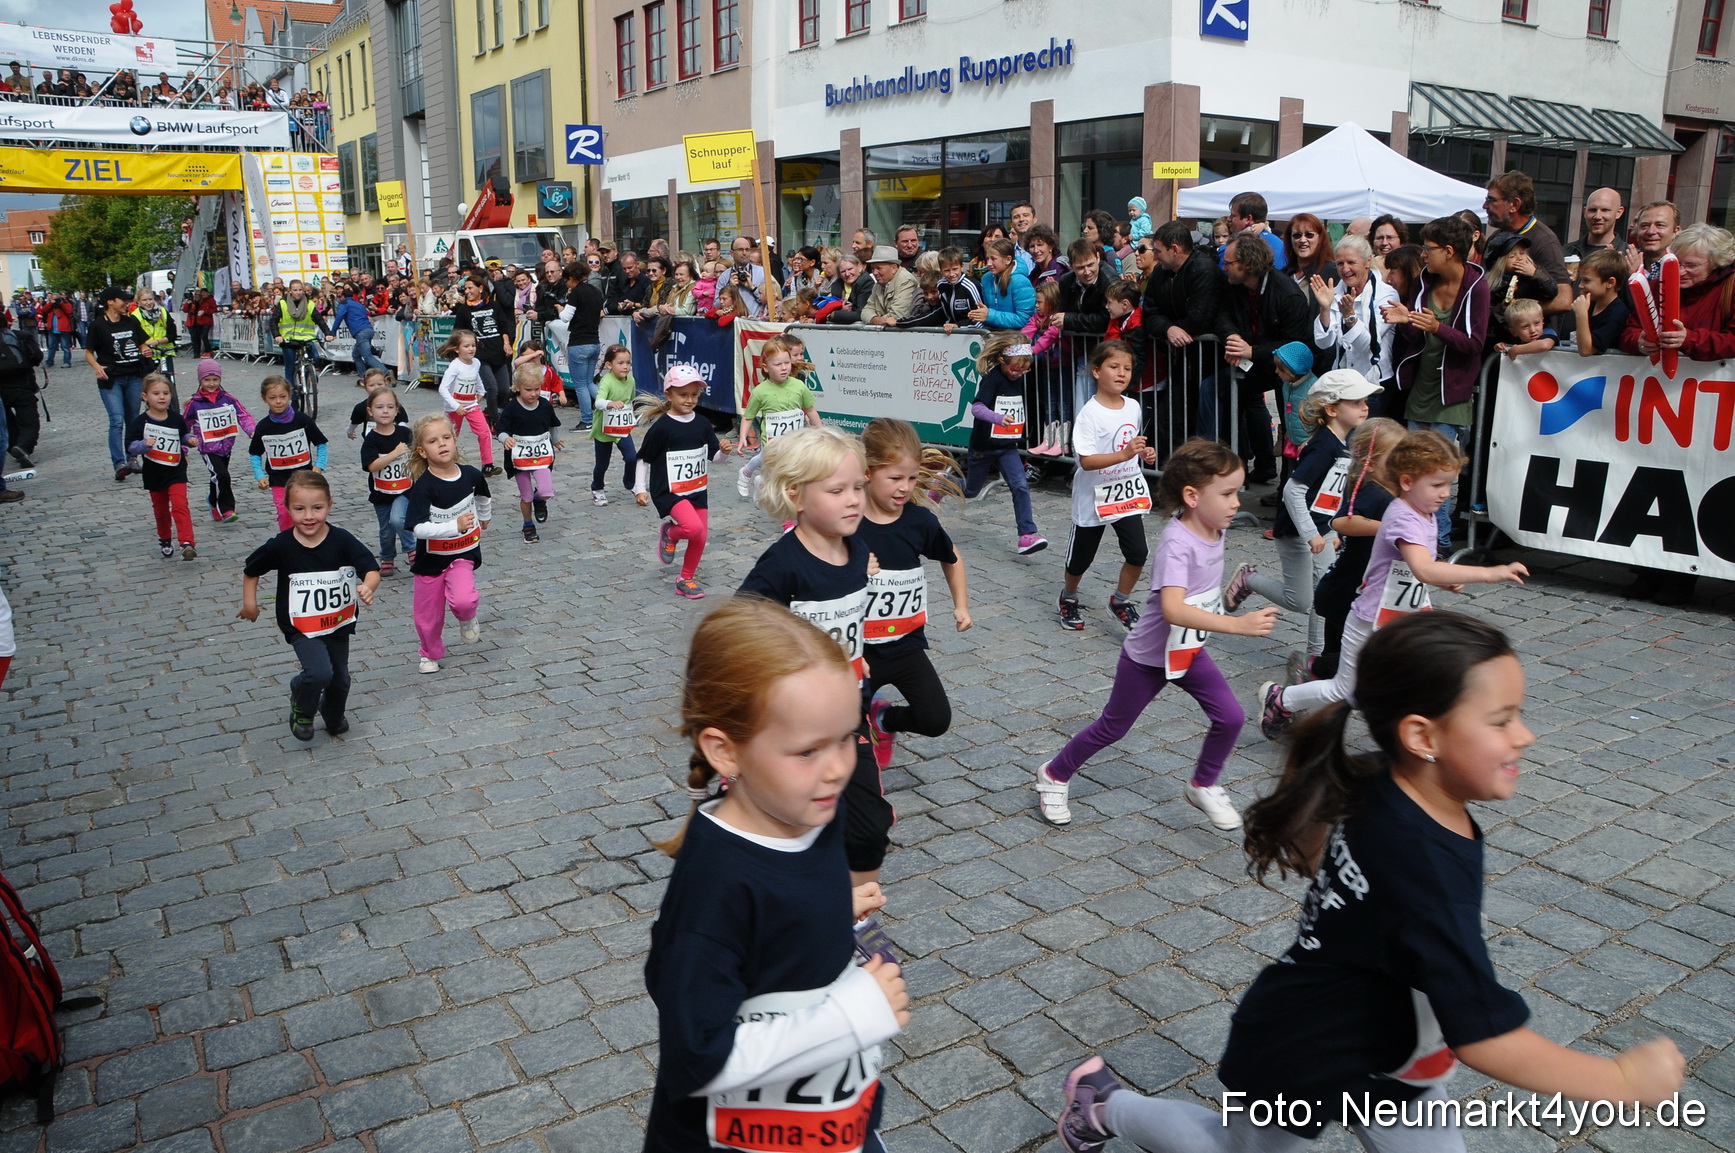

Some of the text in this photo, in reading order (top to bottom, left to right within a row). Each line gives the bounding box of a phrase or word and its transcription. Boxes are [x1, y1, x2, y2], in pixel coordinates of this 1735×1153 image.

[32, 31, 111, 45] LEBENSSPENDER
[53, 45, 96, 56] WERDEN!
[825, 37, 1074, 107] Buchhandlung Rupprecht
[1715, 107, 1720, 115] 2
[157, 122, 259, 136] BMW Laufsport
[690, 145, 751, 158] Schnupper-
[64, 158, 133, 182] ZIEL
[712, 159, 731, 169] lauf
[1161, 166, 1192, 176] Infopoint
[379, 192, 403, 203] Jugend
[387, 199, 400, 208] lauf
[552, 191, 564, 207] G2
[836, 347, 885, 359] Gebäudereinigung
[928, 350, 949, 362] UNS
[836, 360, 887, 371] Hausmeisterdienste
[838, 374, 867, 384] Mietservice
[842, 387, 893, 399] Event-Leit-Systeme
[608, 412, 633, 426] 7190
[1615, 374, 1735, 452] INT
[204, 412, 233, 430] 7051
[269, 440, 303, 457] 7212
[673, 458, 706, 480] 7340
[1102, 477, 1145, 503] 7289
[442, 536, 474, 550] Carlotta
[1391, 568, 1413, 578] PAR
[887, 575, 923, 586] Neumarkt
[297, 582, 351, 613] 7059
[865, 586, 923, 617] 7375
[320, 616, 338, 628] Mia
[727, 1116, 873, 1147] Anna-So
